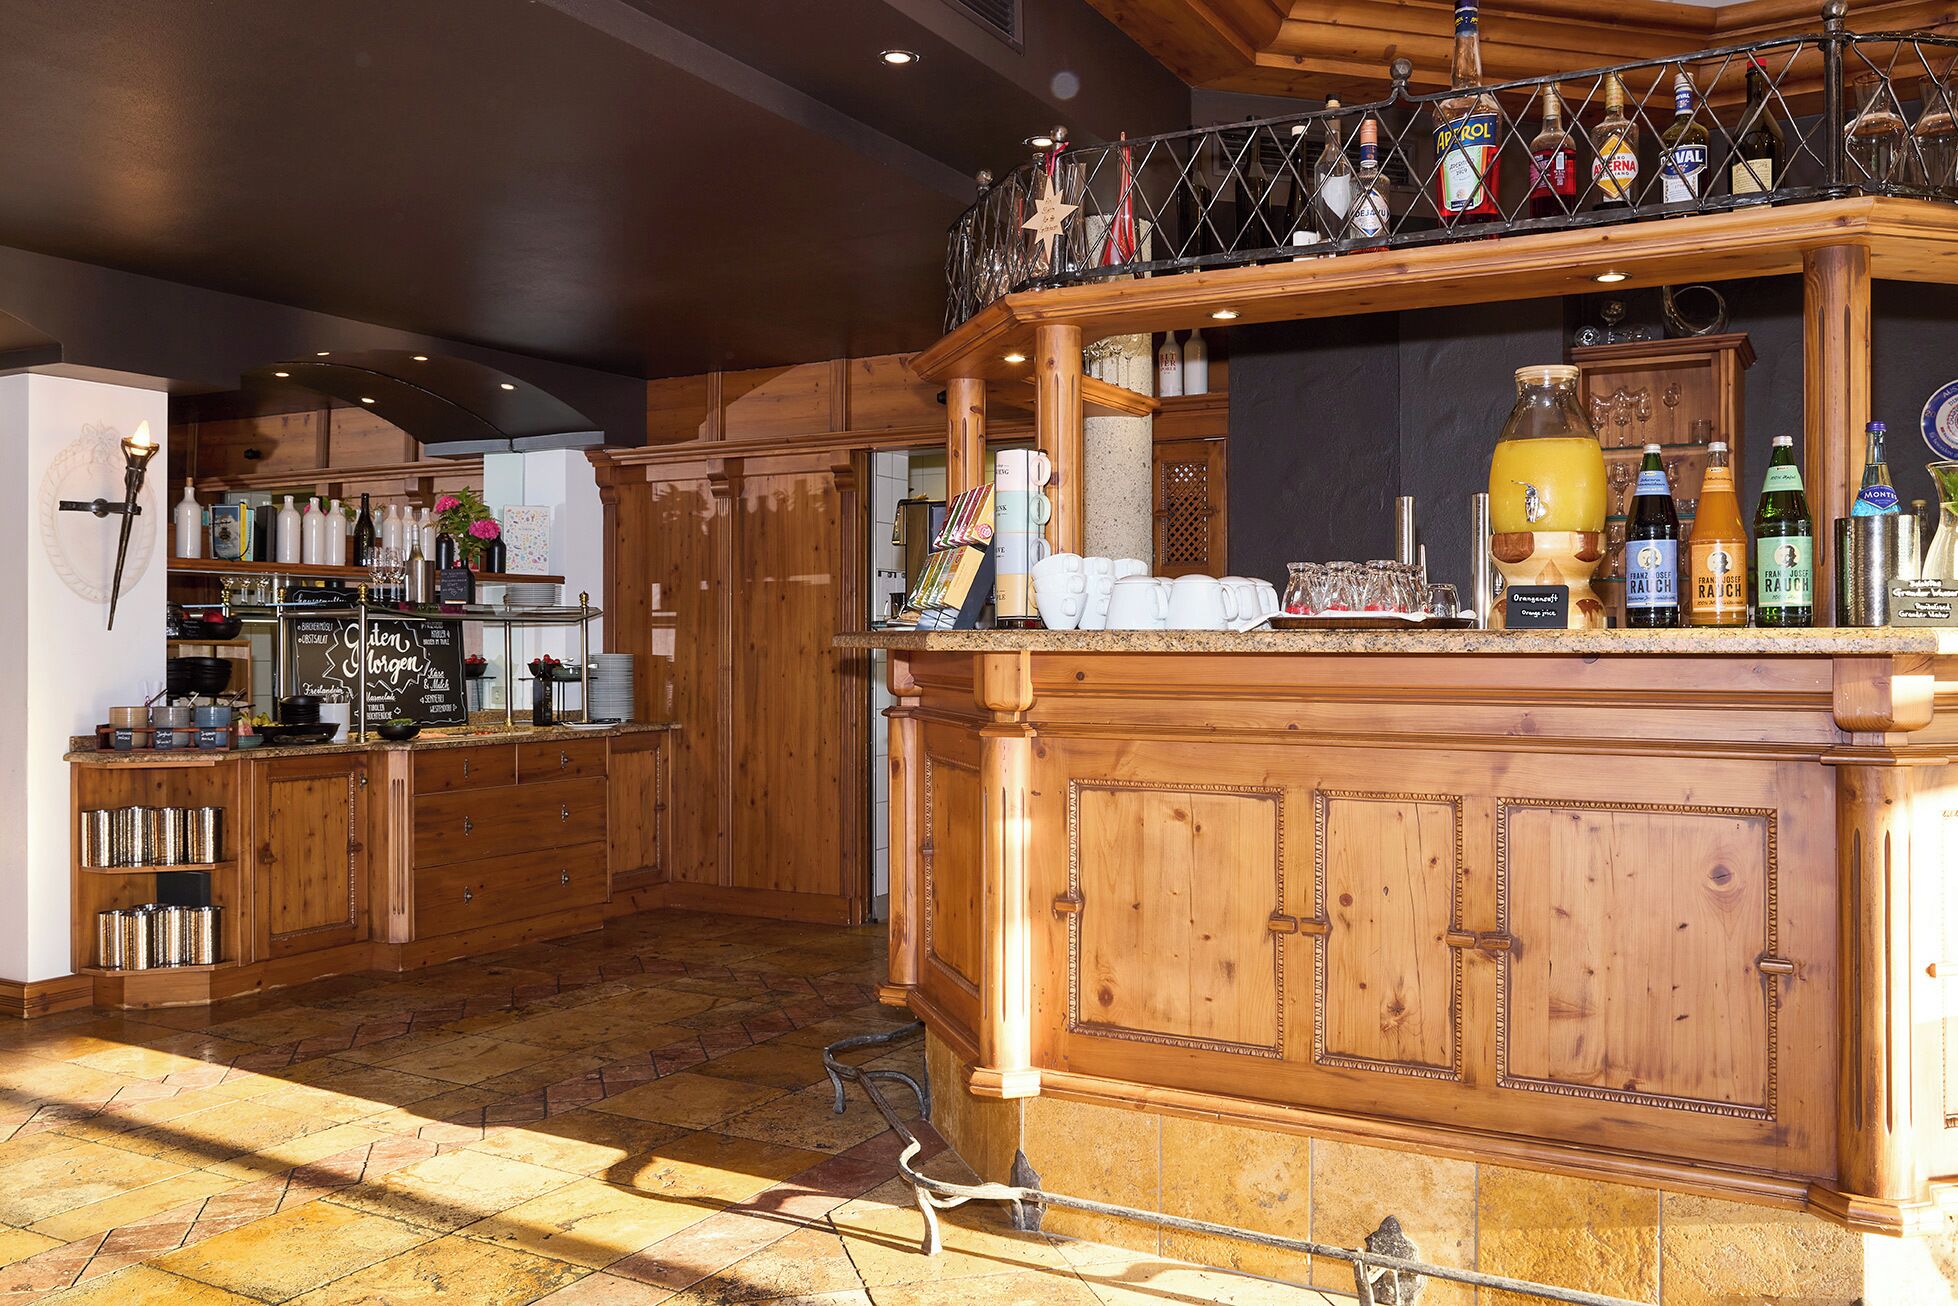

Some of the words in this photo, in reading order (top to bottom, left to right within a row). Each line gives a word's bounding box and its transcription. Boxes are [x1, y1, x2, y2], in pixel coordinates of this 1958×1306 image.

[1661, 149, 1703, 168] DVAL
[1655, 571, 1671, 579] OSEF
[1698, 576, 1717, 584] FRAN
[1722, 575, 1741, 584] JOSEF
[1765, 570, 1783, 578] FRAN
[1789, 569, 1808, 578] JOSEF
[1630, 579, 1671, 594] RAUCH
[1698, 583, 1742, 598] RAUCH
[1765, 577, 1808, 592] RAUCH
[1521, 609, 1541, 618] Orange
[1541, 608, 1557, 617] juice
